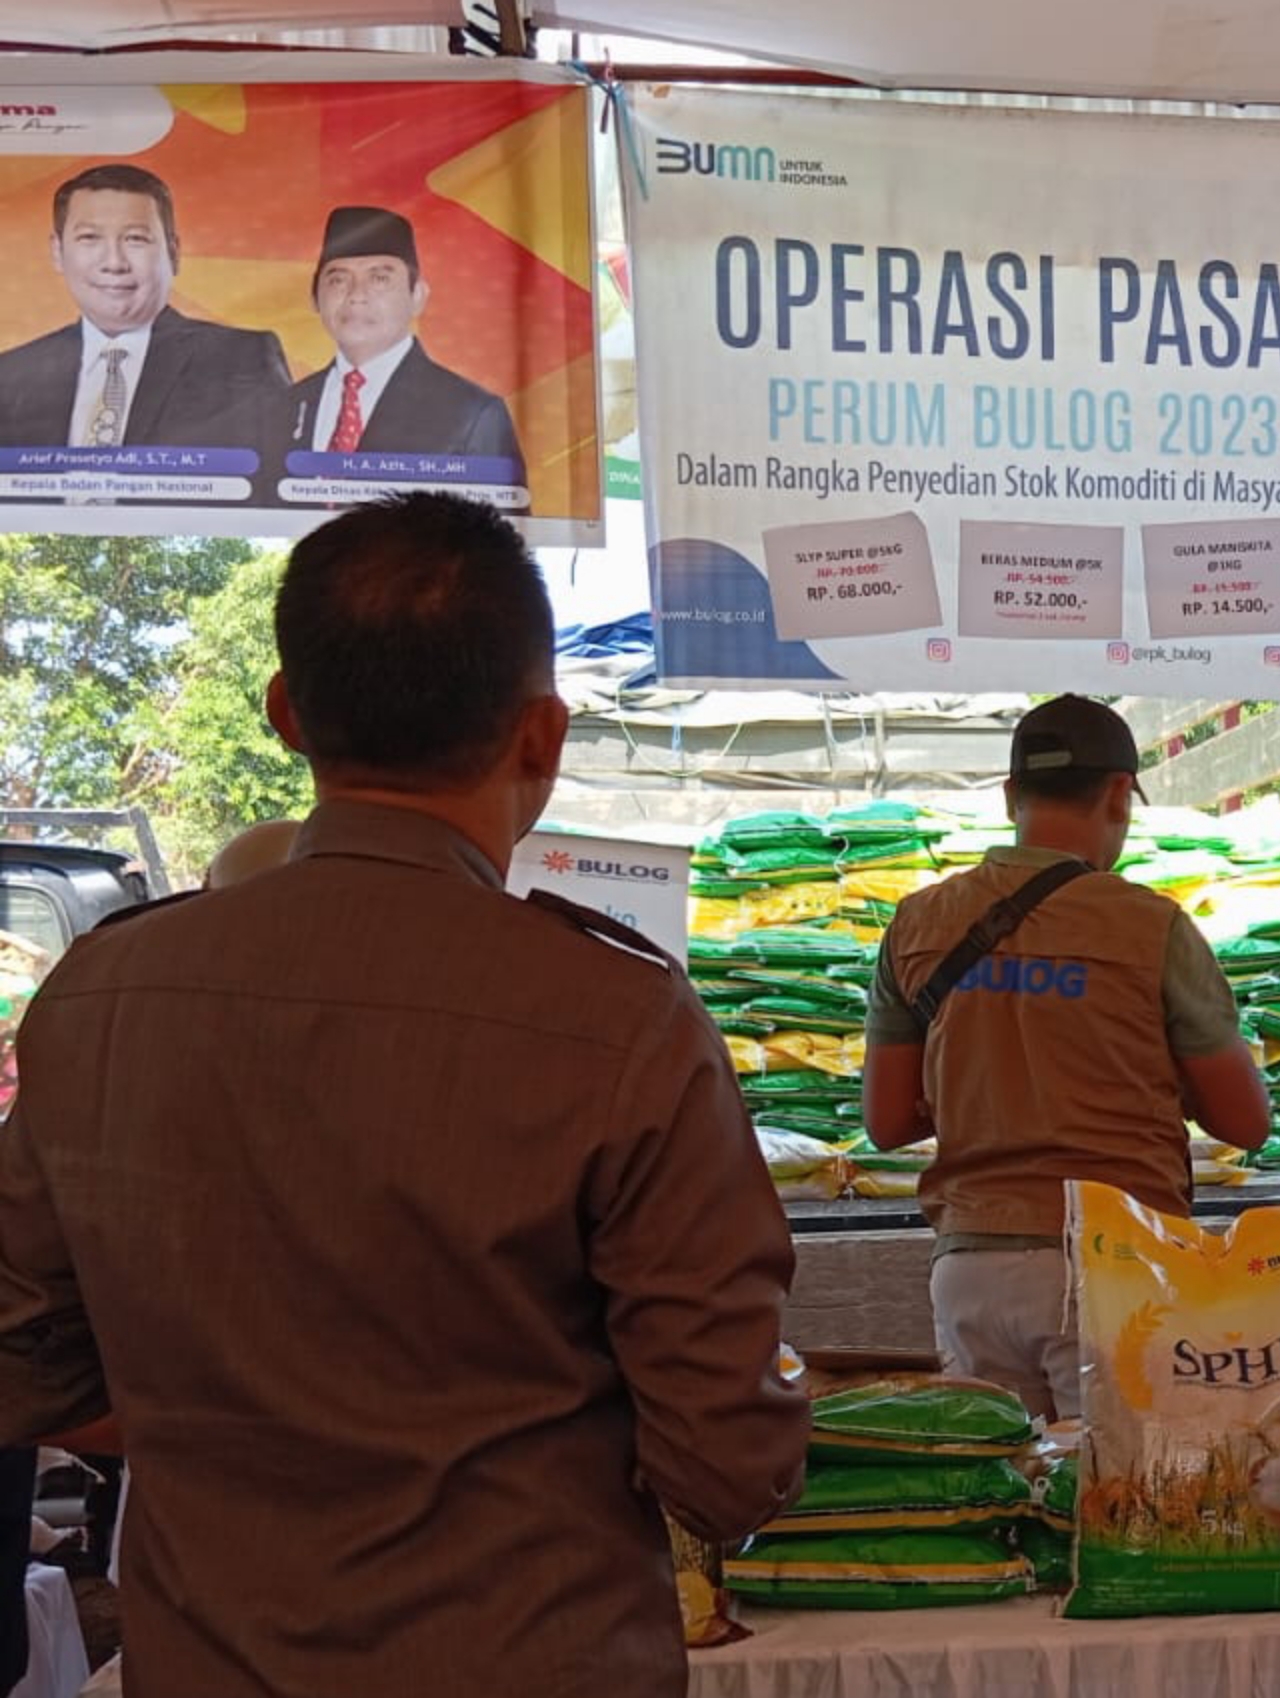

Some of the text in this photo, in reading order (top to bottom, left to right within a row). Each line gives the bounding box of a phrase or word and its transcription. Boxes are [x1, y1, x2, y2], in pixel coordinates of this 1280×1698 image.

[780, 161, 824, 172] UNTUK
[780, 173, 848, 186] INDONESIA
[714, 235, 1056, 362] OPERASI
[768, 377, 1279, 457] PERUM BULOG 2023
[11, 479, 214, 494] Kepala Badan Pangan Nasional
[677, 453, 758, 488] Dalam
[766, 457, 861, 499] Rangka
[868, 461, 997, 502] Penyedian
[1005, 465, 1058, 499] Stok
[1065, 466, 1177, 501] Komoditi
[1183, 470, 1207, 500] di
[825, 547, 865, 562] SUPER
[1173, 544, 1206, 557] GULA
[981, 553, 1019, 566] BERAS
[1020, 555, 1074, 570] MEDIUM
[806, 580, 904, 602] RP. 68.000,-
[993, 590, 1089, 610] RP. 52.000,-
[1182, 598, 1275, 617] RP. 14.500,-
[1131, 647, 1212, 665] @rpk_bulog
[576, 859, 671, 881] BULOG
